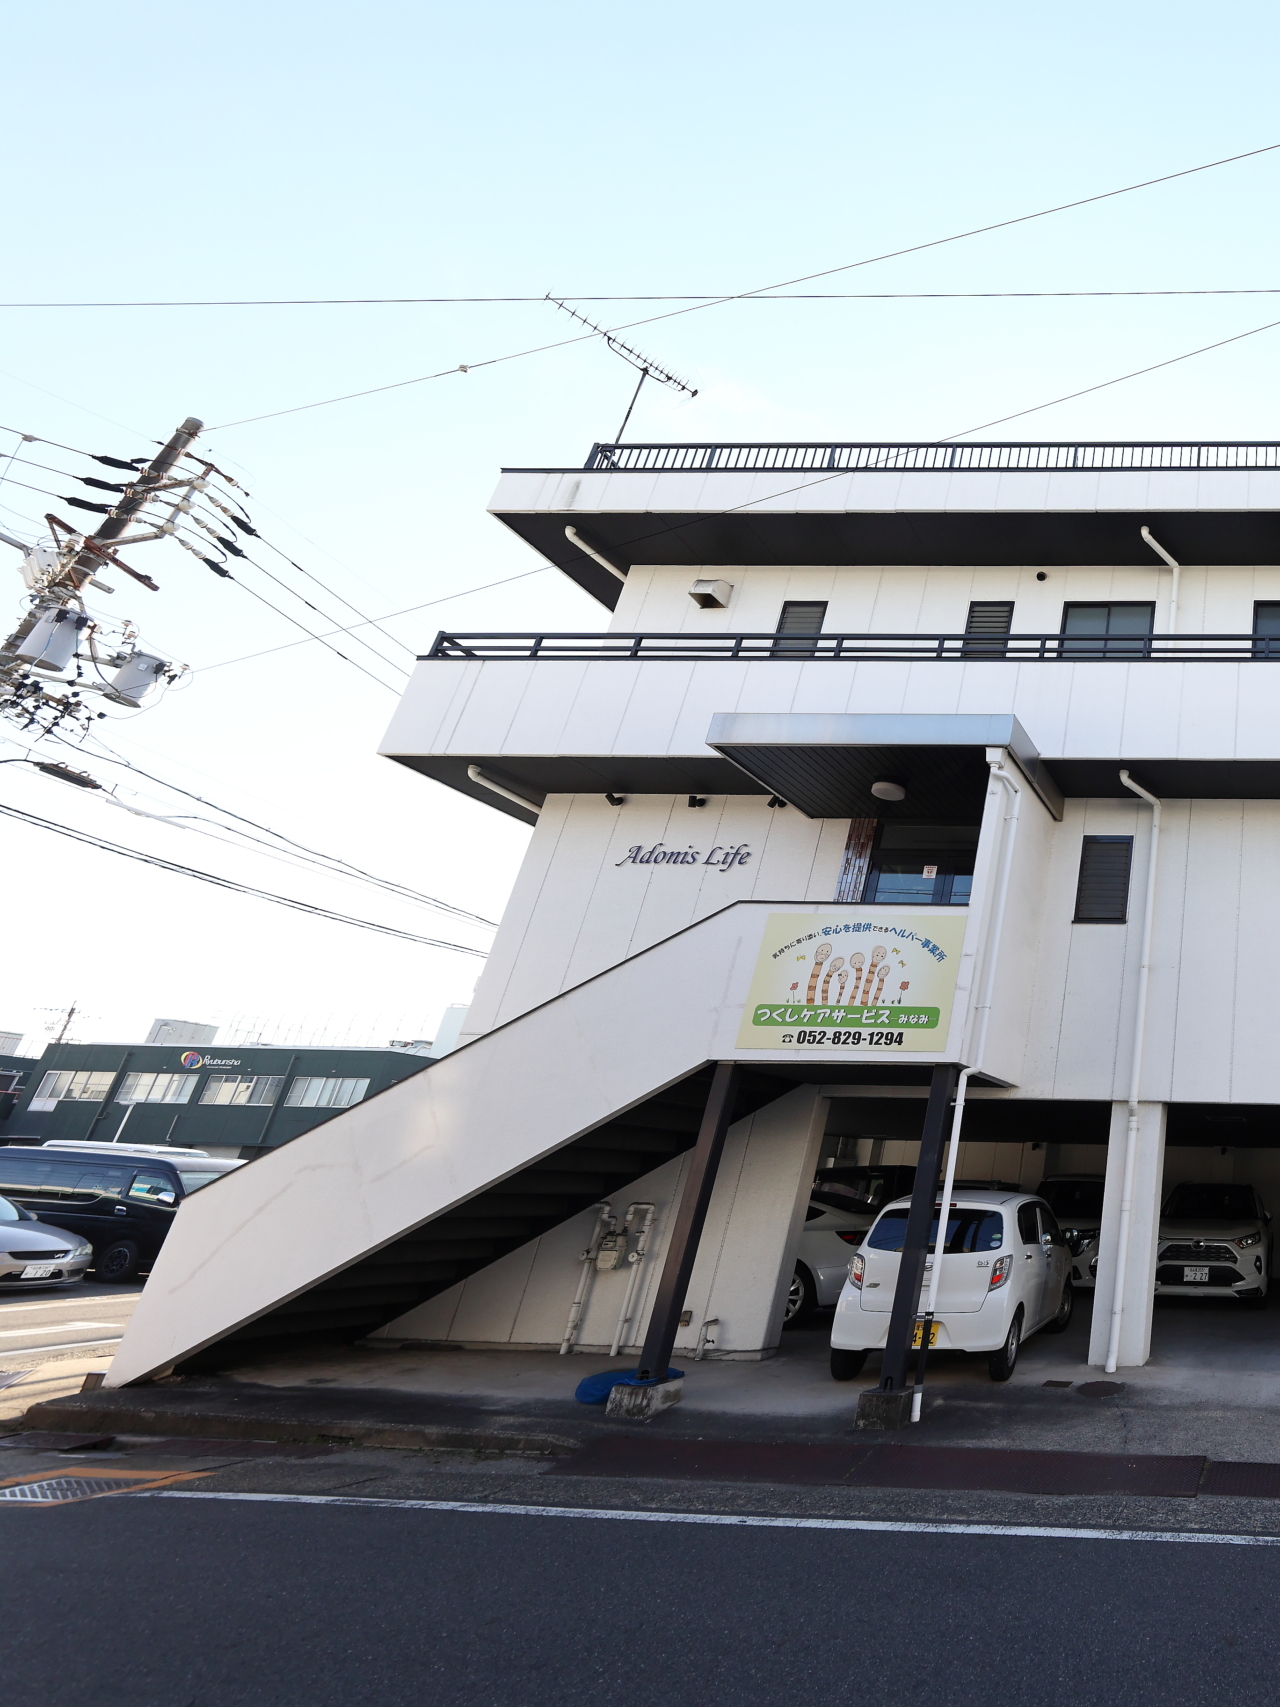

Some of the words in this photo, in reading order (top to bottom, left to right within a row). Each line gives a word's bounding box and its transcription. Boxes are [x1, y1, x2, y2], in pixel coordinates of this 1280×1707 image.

[615, 842, 700, 867] Adonis
[702, 843, 751, 872] Life
[757, 1007, 891, 1025] つくしケアサービス
[796, 1030, 904, 1046] 052-829-1294
